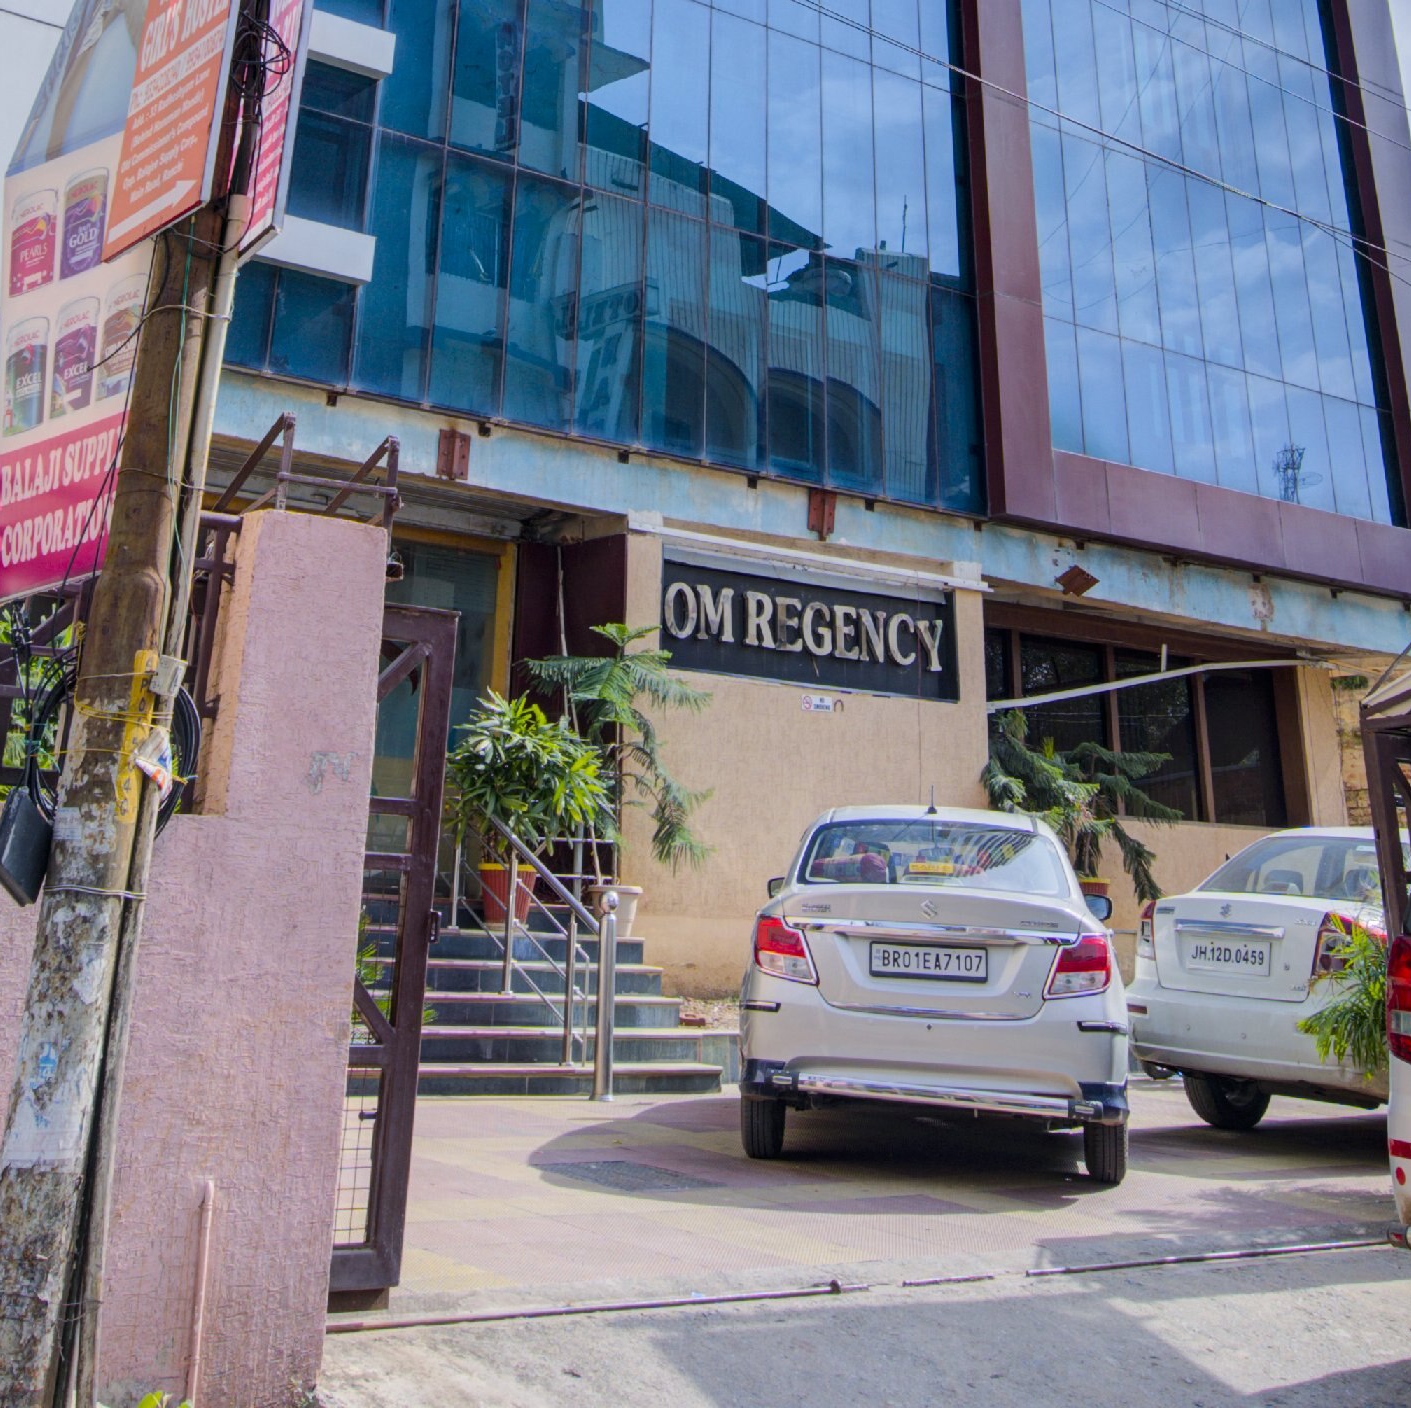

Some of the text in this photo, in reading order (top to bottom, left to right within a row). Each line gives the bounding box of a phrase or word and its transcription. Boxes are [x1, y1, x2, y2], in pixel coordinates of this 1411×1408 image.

[69, 227, 98, 249] GOLD
[19, 242, 48, 264] PEARLS
[0, 447, 63, 507] BALAJI
[662, 581, 943, 672] OM REGENCY
[881, 948, 983, 973] BR01EA7107
